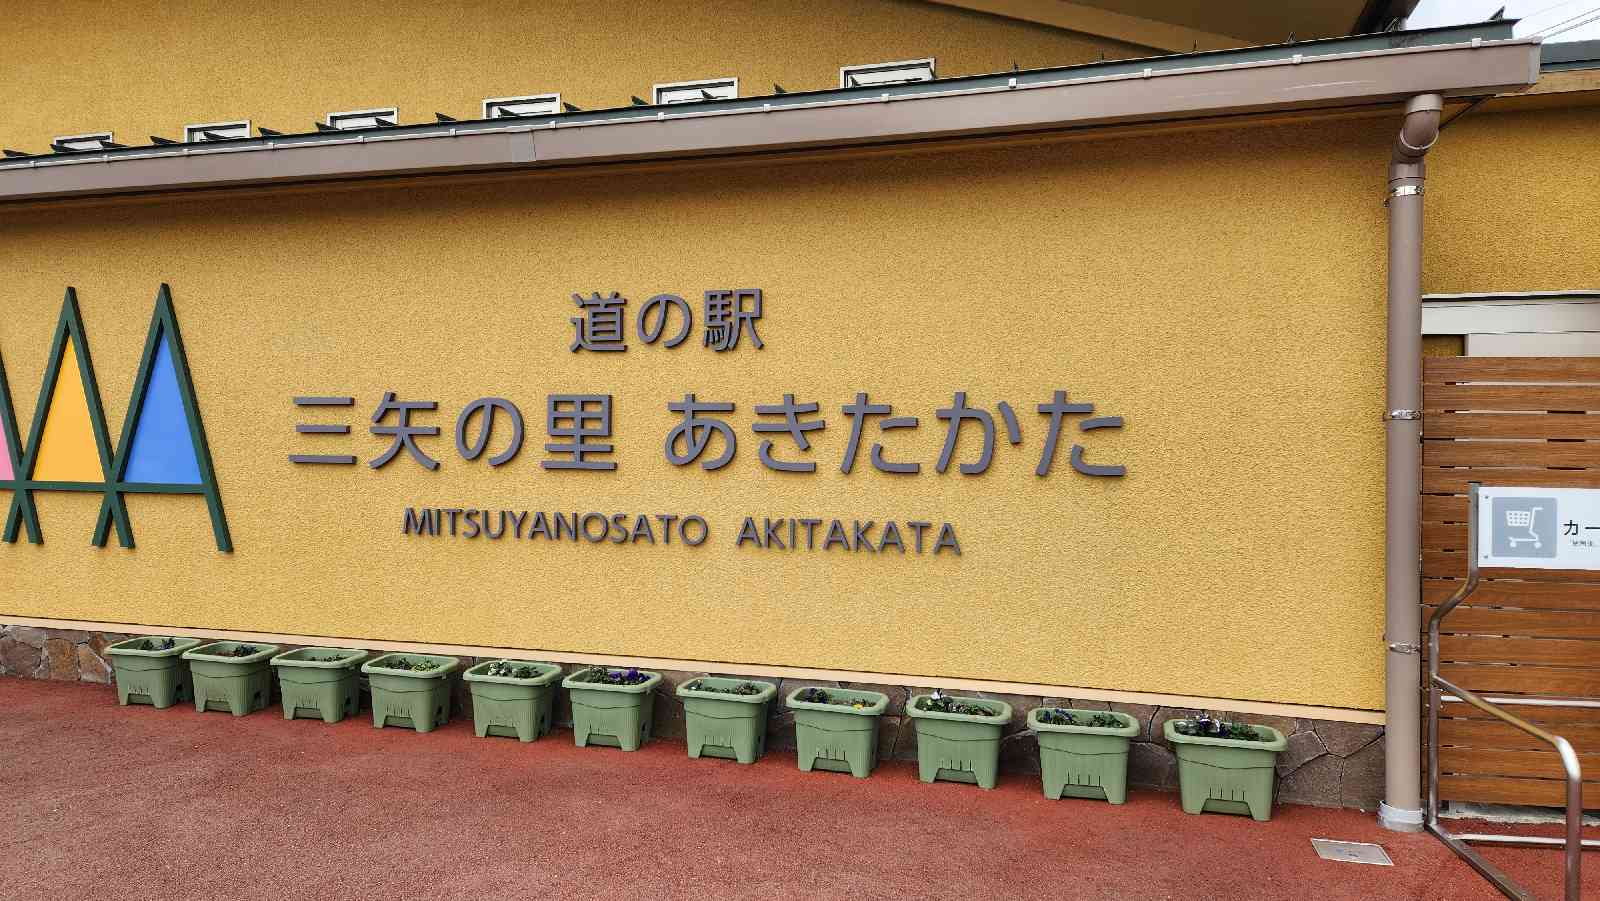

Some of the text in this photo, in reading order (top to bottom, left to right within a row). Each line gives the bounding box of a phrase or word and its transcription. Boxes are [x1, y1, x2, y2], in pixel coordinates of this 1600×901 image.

[570, 288, 764, 353] 道の駅
[288, 390, 1126, 477] 三矢の里 あきたかた
[402, 507, 962, 556] MITSUYANOSATO AKITAKATA
